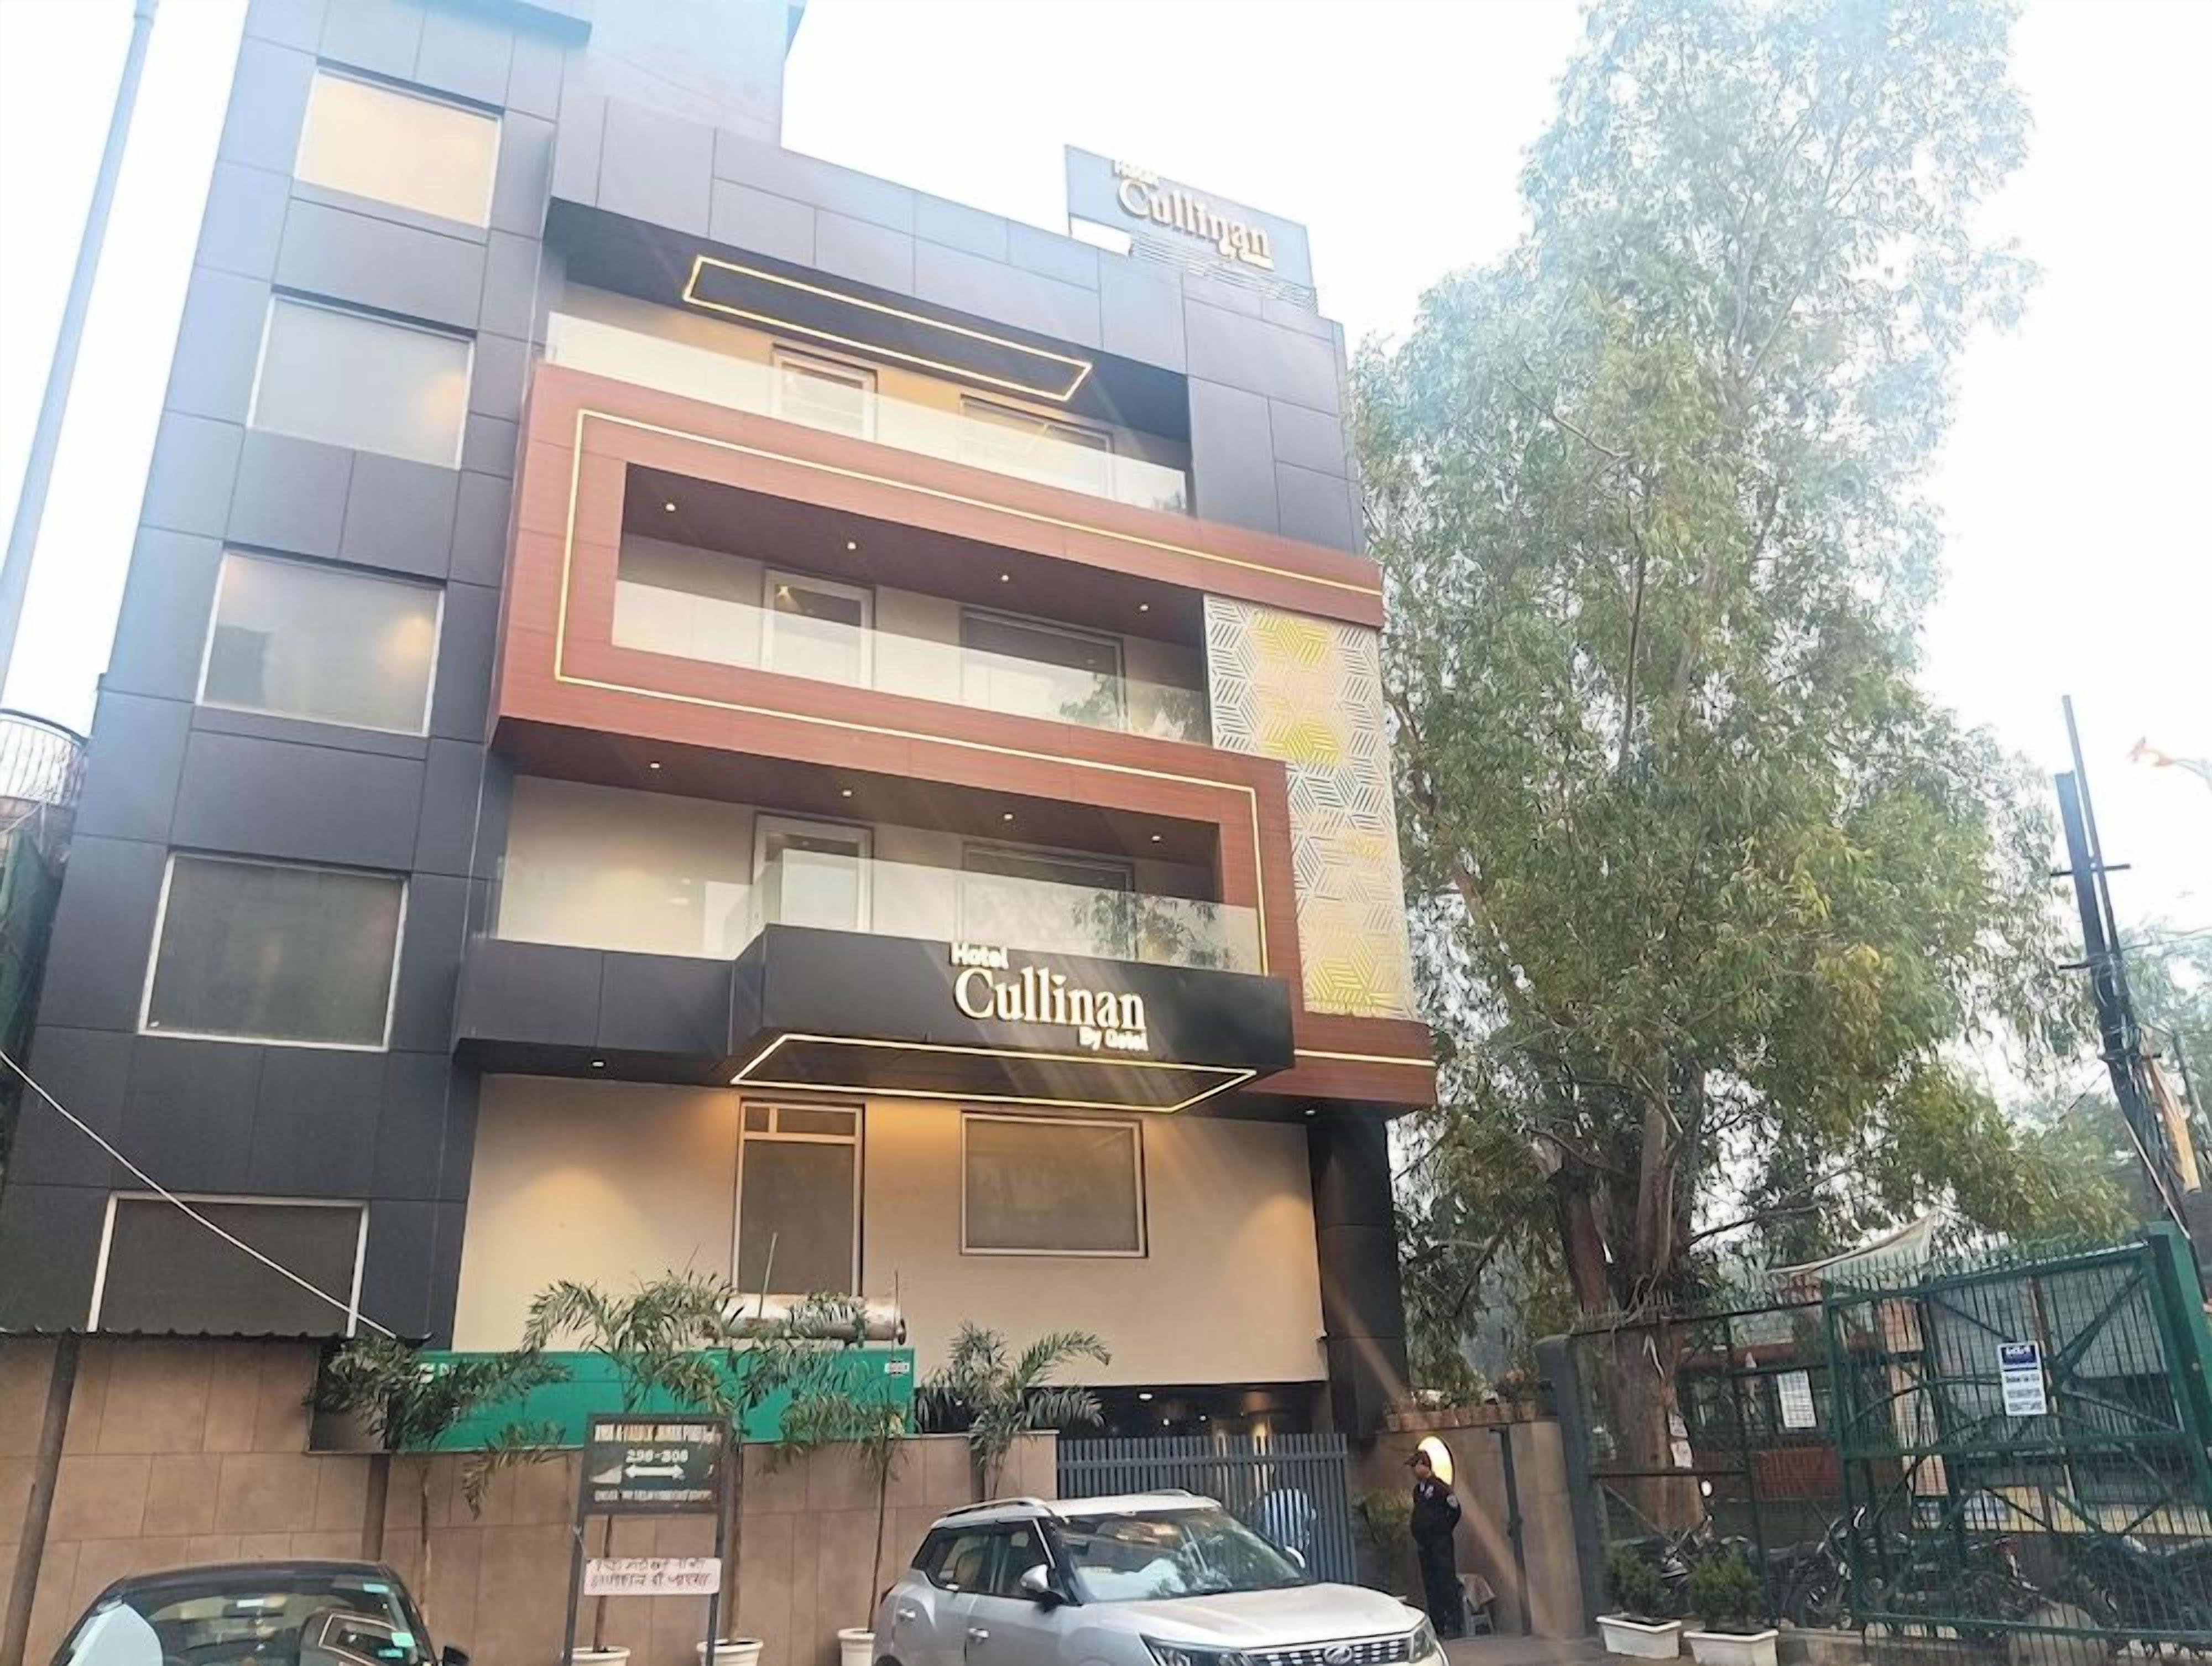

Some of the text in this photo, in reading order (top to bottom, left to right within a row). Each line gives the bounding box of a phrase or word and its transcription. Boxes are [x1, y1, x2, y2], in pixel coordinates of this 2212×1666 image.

[1118, 179, 1271, 258] Cullinan
[951, 941, 1009, 969] Hotel
[955, 965, 1146, 1030] Cullinan
